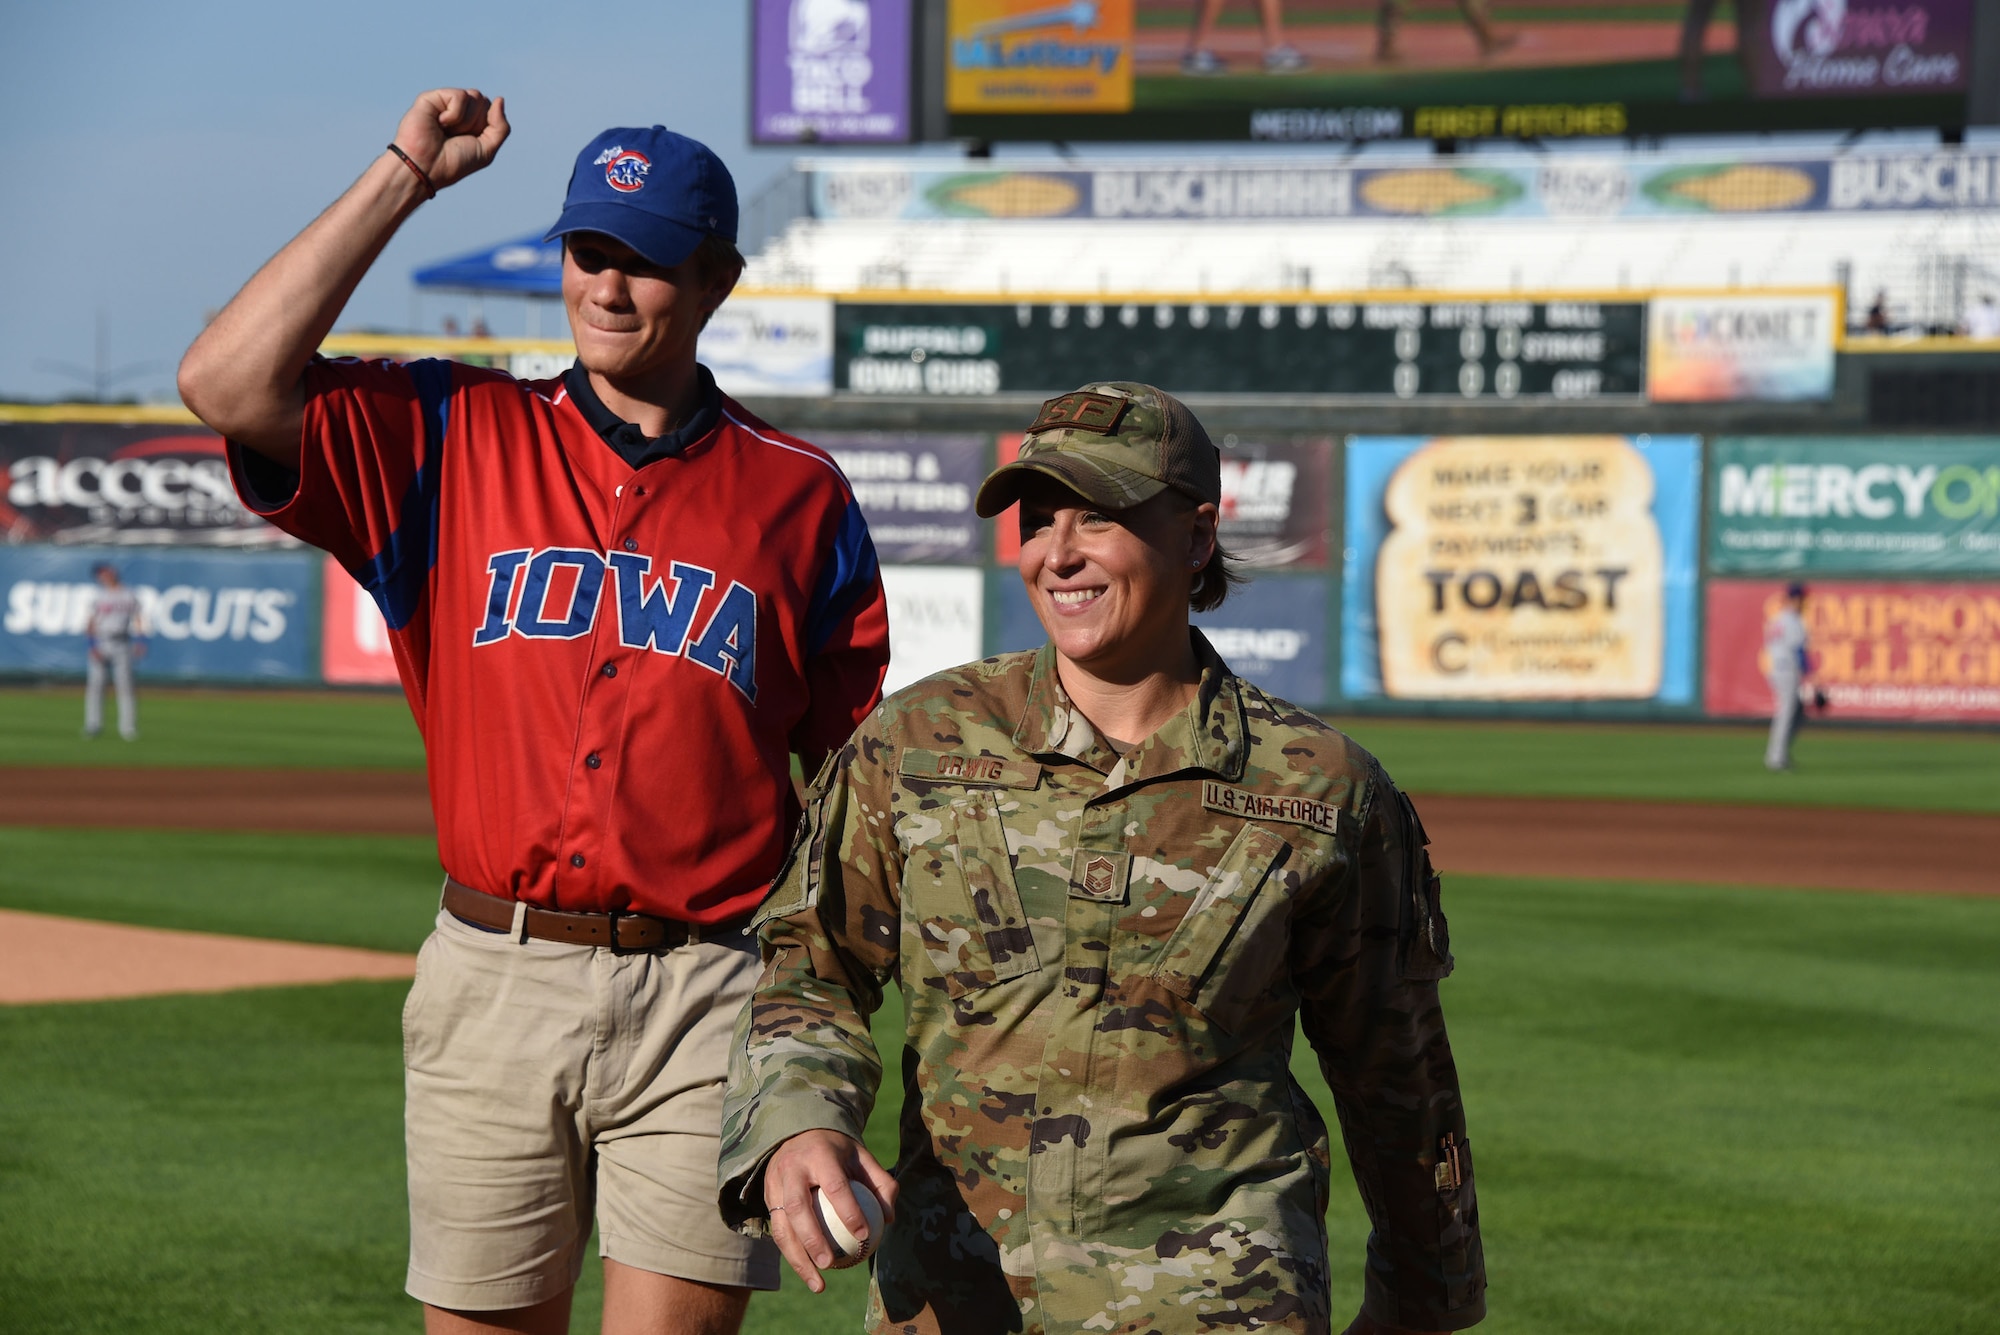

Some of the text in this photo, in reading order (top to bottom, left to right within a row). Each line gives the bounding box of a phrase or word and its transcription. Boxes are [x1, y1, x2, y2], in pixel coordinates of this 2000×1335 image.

[787, 53, 874, 87] TACO
[791, 86, 873, 114] BELL
[1249, 103, 1628, 140] MEDIACOM FIRST PITCHES
[863, 324, 987, 354] BUFFALO
[848, 357, 923, 394] IOWA
[924, 357, 1000, 395] CUBS
[8, 456, 236, 508] acces
[915, 452, 941, 481] &
[88, 505, 260, 526] SYSTEM
[1514, 493, 1538, 525] 3
[1424, 567, 1629, 613] TOAST
[4, 582, 287, 643] SUPRCUTS
[473, 546, 759, 707] IOWA
[936, 755, 1004, 780] ORWIG
[1206, 784, 1335, 829] U.S. AIR FORCE
